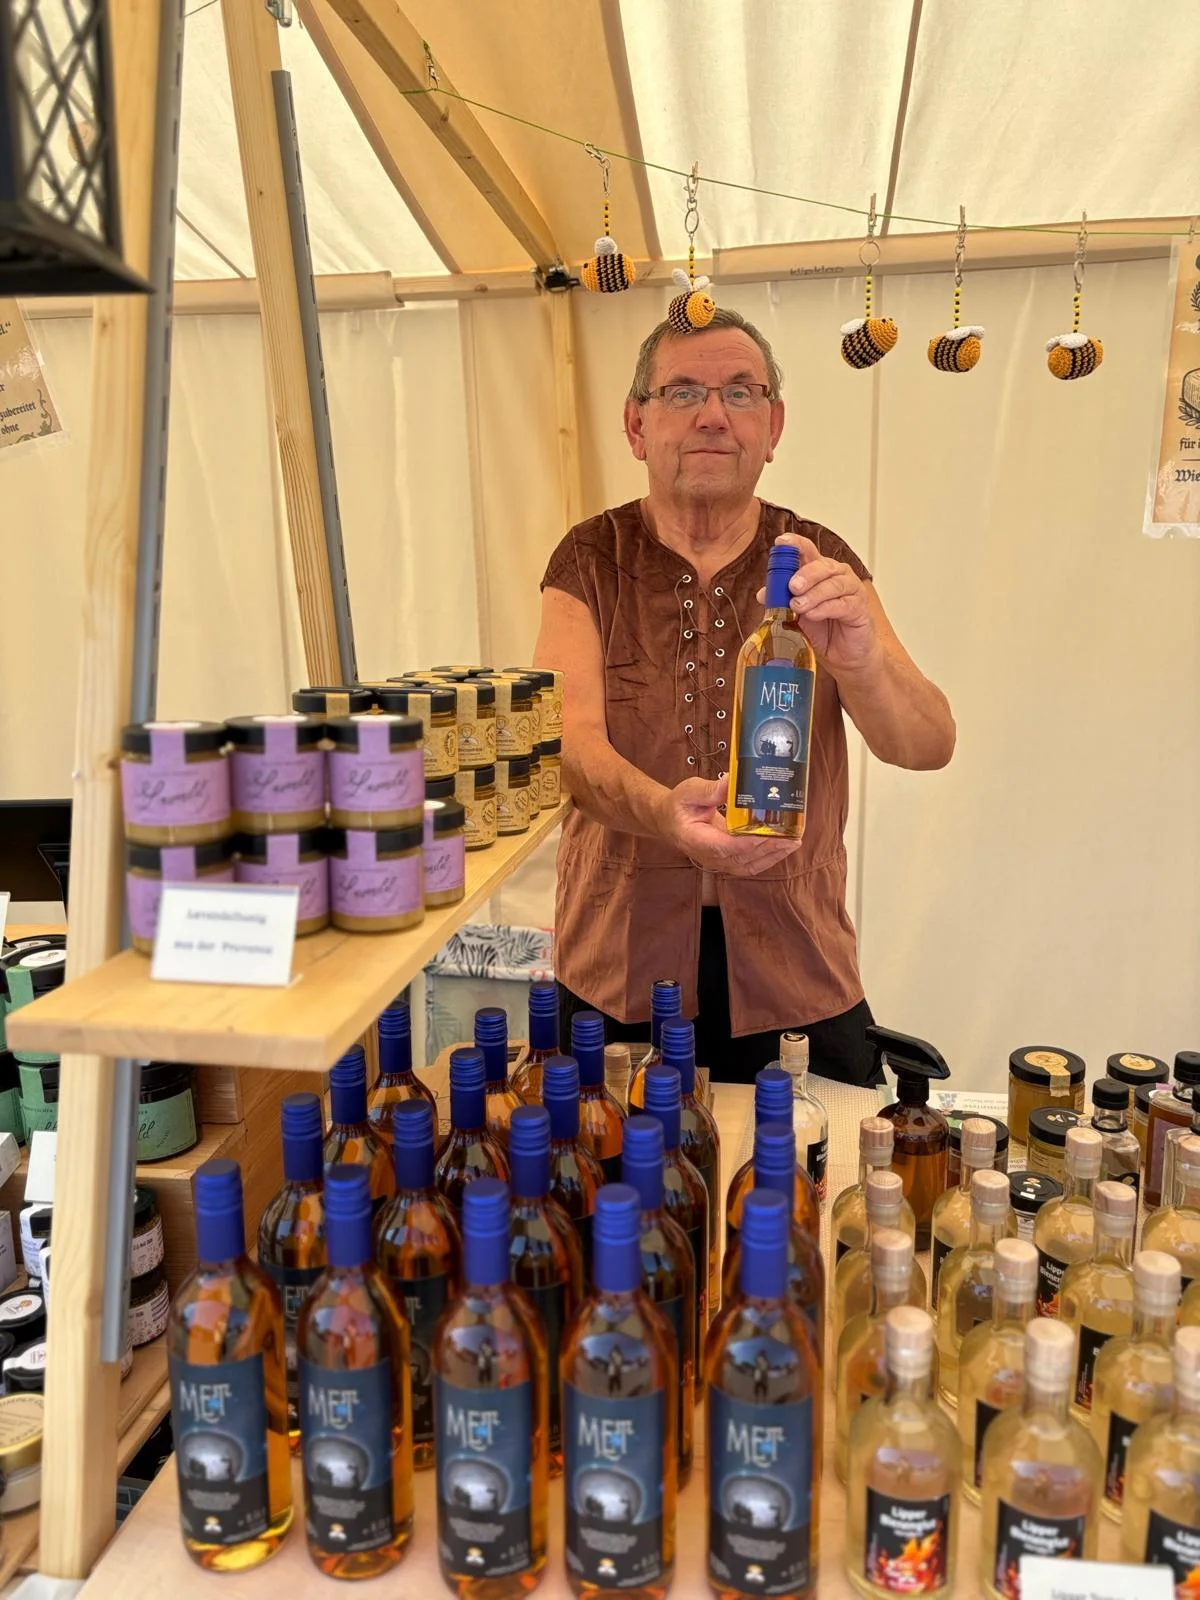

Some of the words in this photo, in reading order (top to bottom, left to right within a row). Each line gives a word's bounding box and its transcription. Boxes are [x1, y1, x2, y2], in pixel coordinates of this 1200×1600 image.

[1179, 437, 1196, 451] für
[760, 681, 800, 711] MET
[180, 1380, 232, 1423] MET
[308, 1384, 360, 1429] MET
[446, 1403, 502, 1451] MET
[578, 1412, 633, 1461] MET
[727, 1418, 785, 1468] MET
